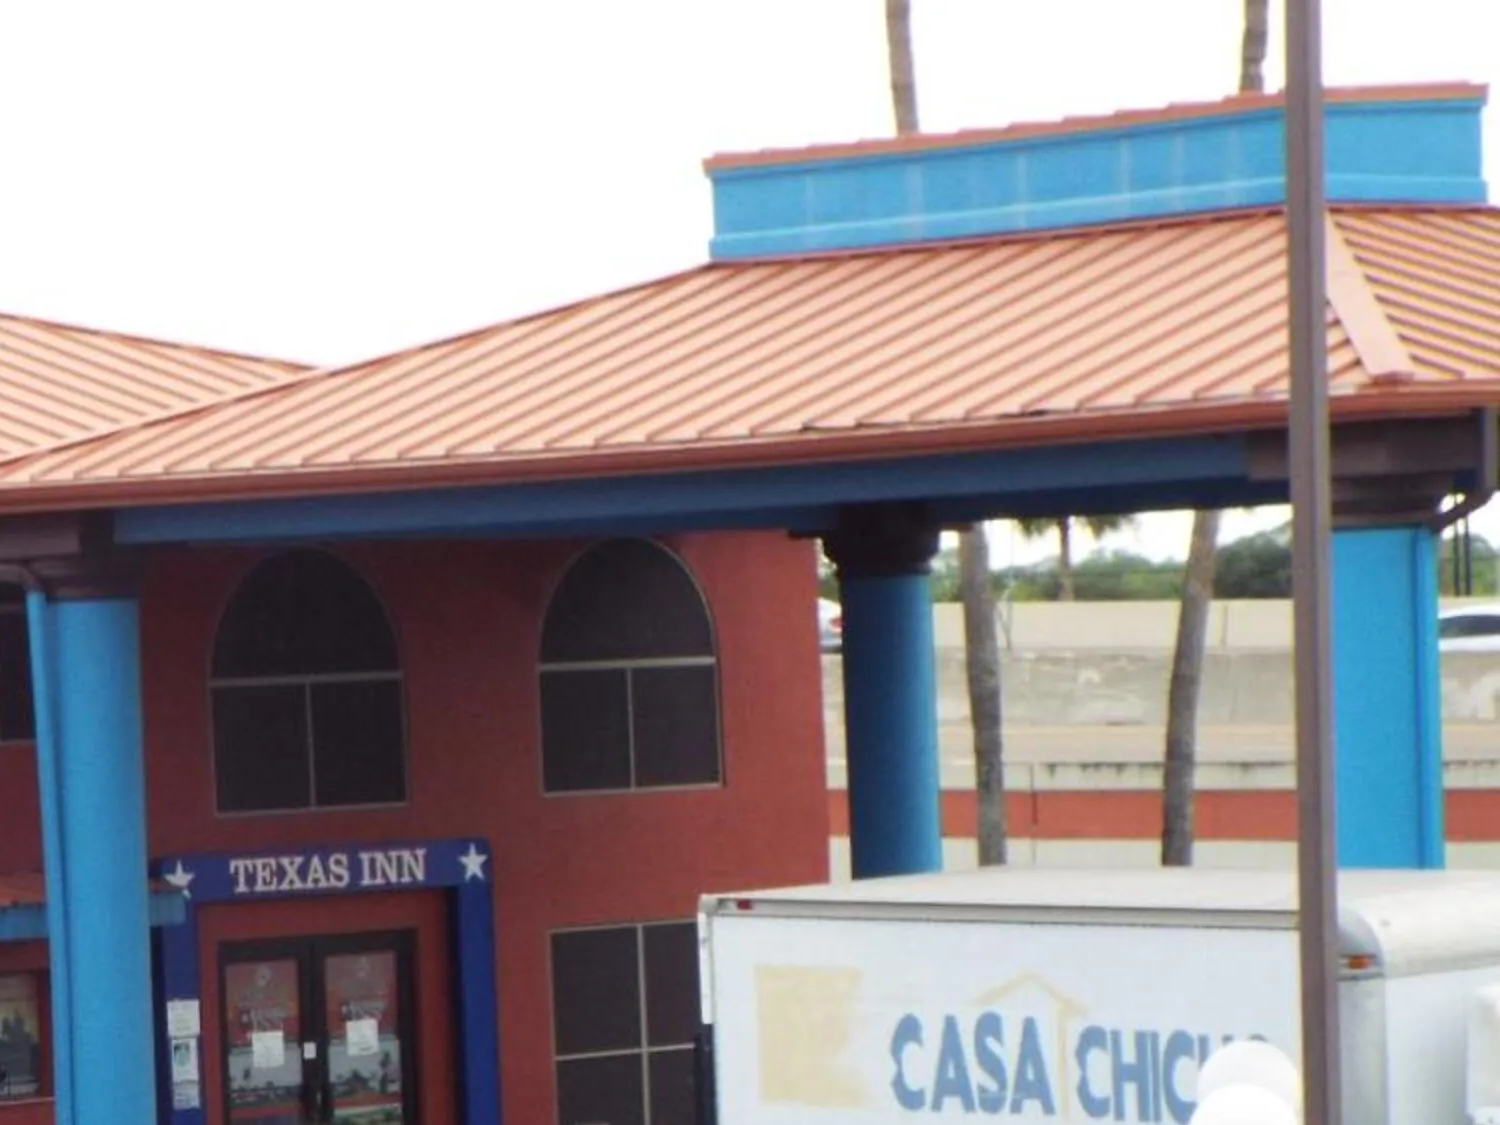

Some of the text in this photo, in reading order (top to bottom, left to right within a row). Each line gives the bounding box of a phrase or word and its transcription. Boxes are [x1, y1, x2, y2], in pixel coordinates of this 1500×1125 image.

[230, 848, 427, 894] TEXAS INN
[891, 1011, 1056, 1115] CASA
